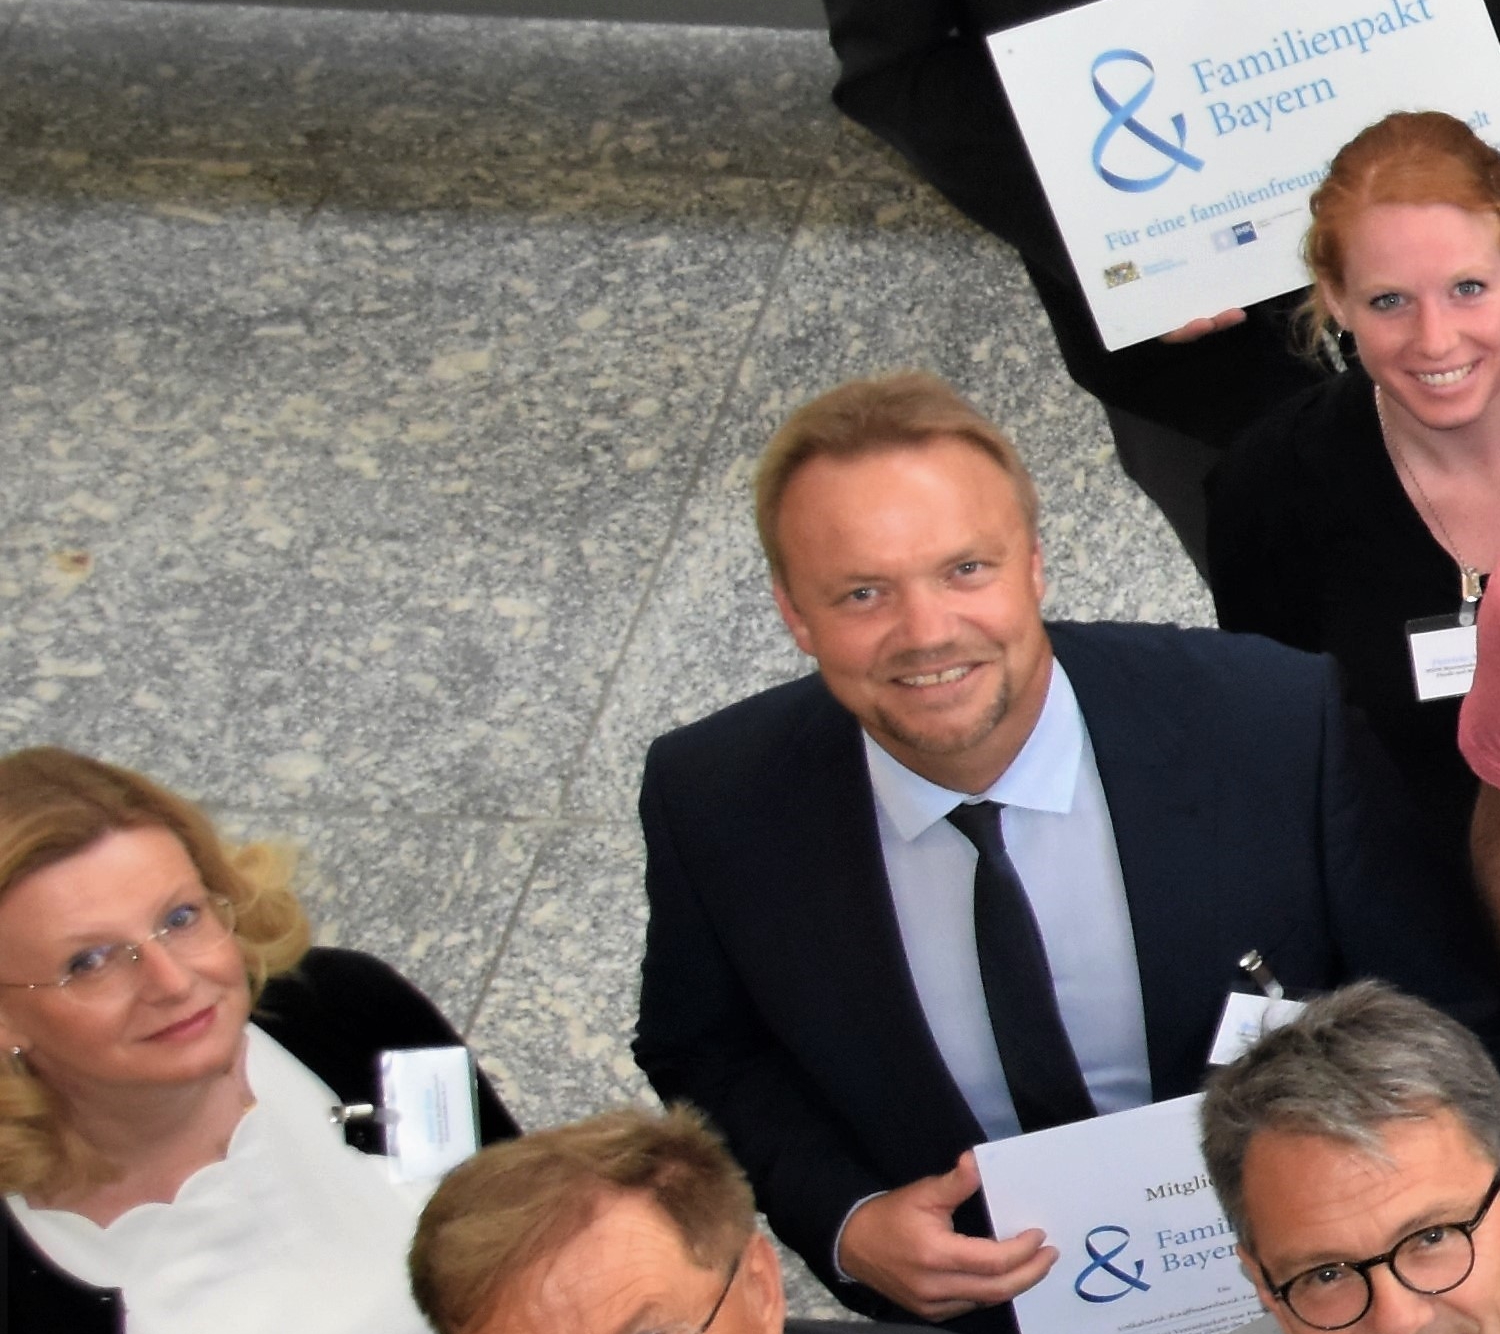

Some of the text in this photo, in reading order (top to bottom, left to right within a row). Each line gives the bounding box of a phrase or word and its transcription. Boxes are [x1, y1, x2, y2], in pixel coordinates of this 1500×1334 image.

[1209, 77, 1337, 140] Bayern
[1104, 228, 1140, 253] Für
[1146, 215, 1187, 238] eine
